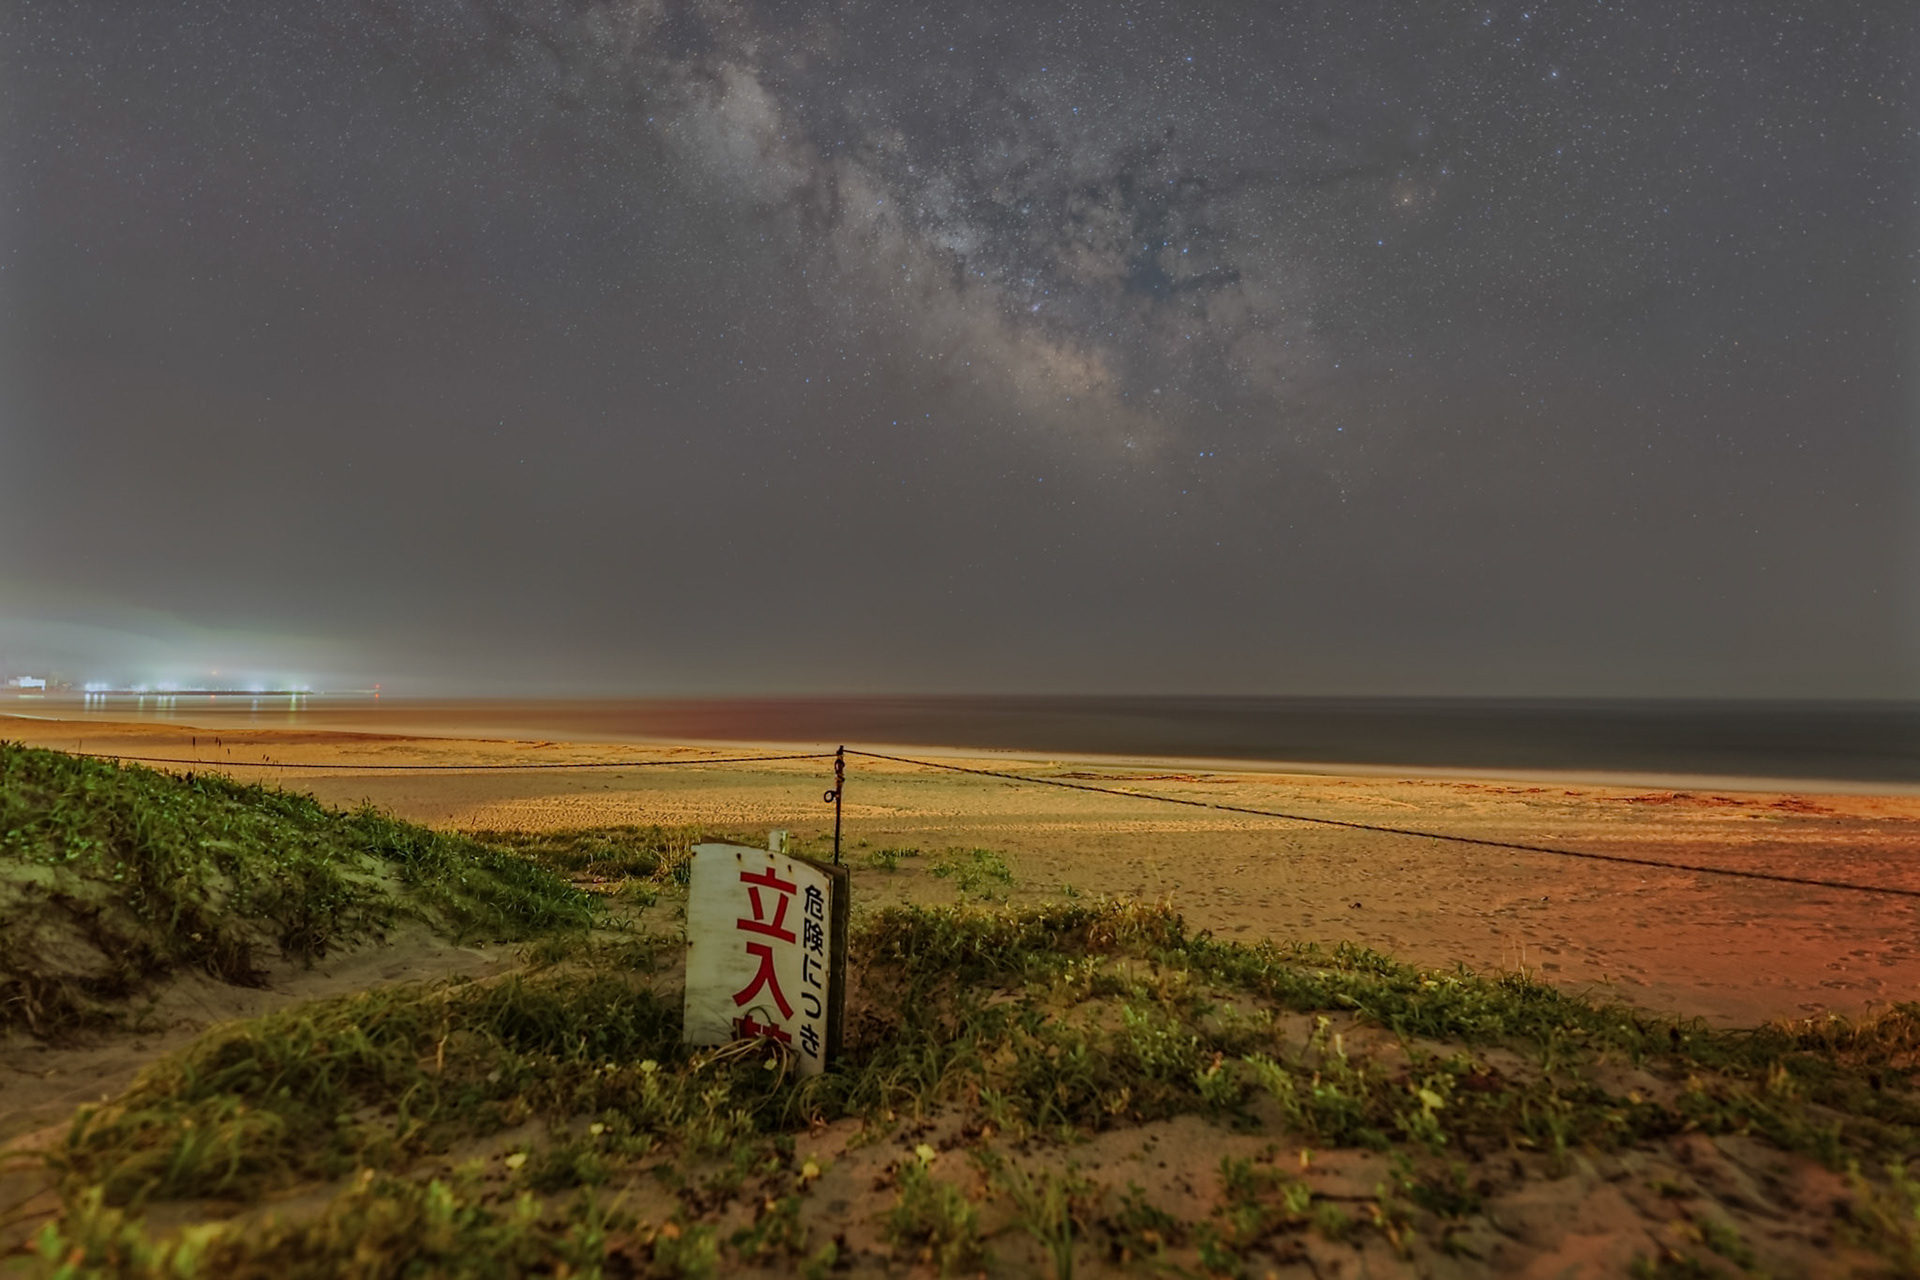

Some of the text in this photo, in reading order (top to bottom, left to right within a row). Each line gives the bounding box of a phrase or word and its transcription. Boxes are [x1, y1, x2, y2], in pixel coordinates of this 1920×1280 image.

[799, 884, 825, 1059] 危険につき
